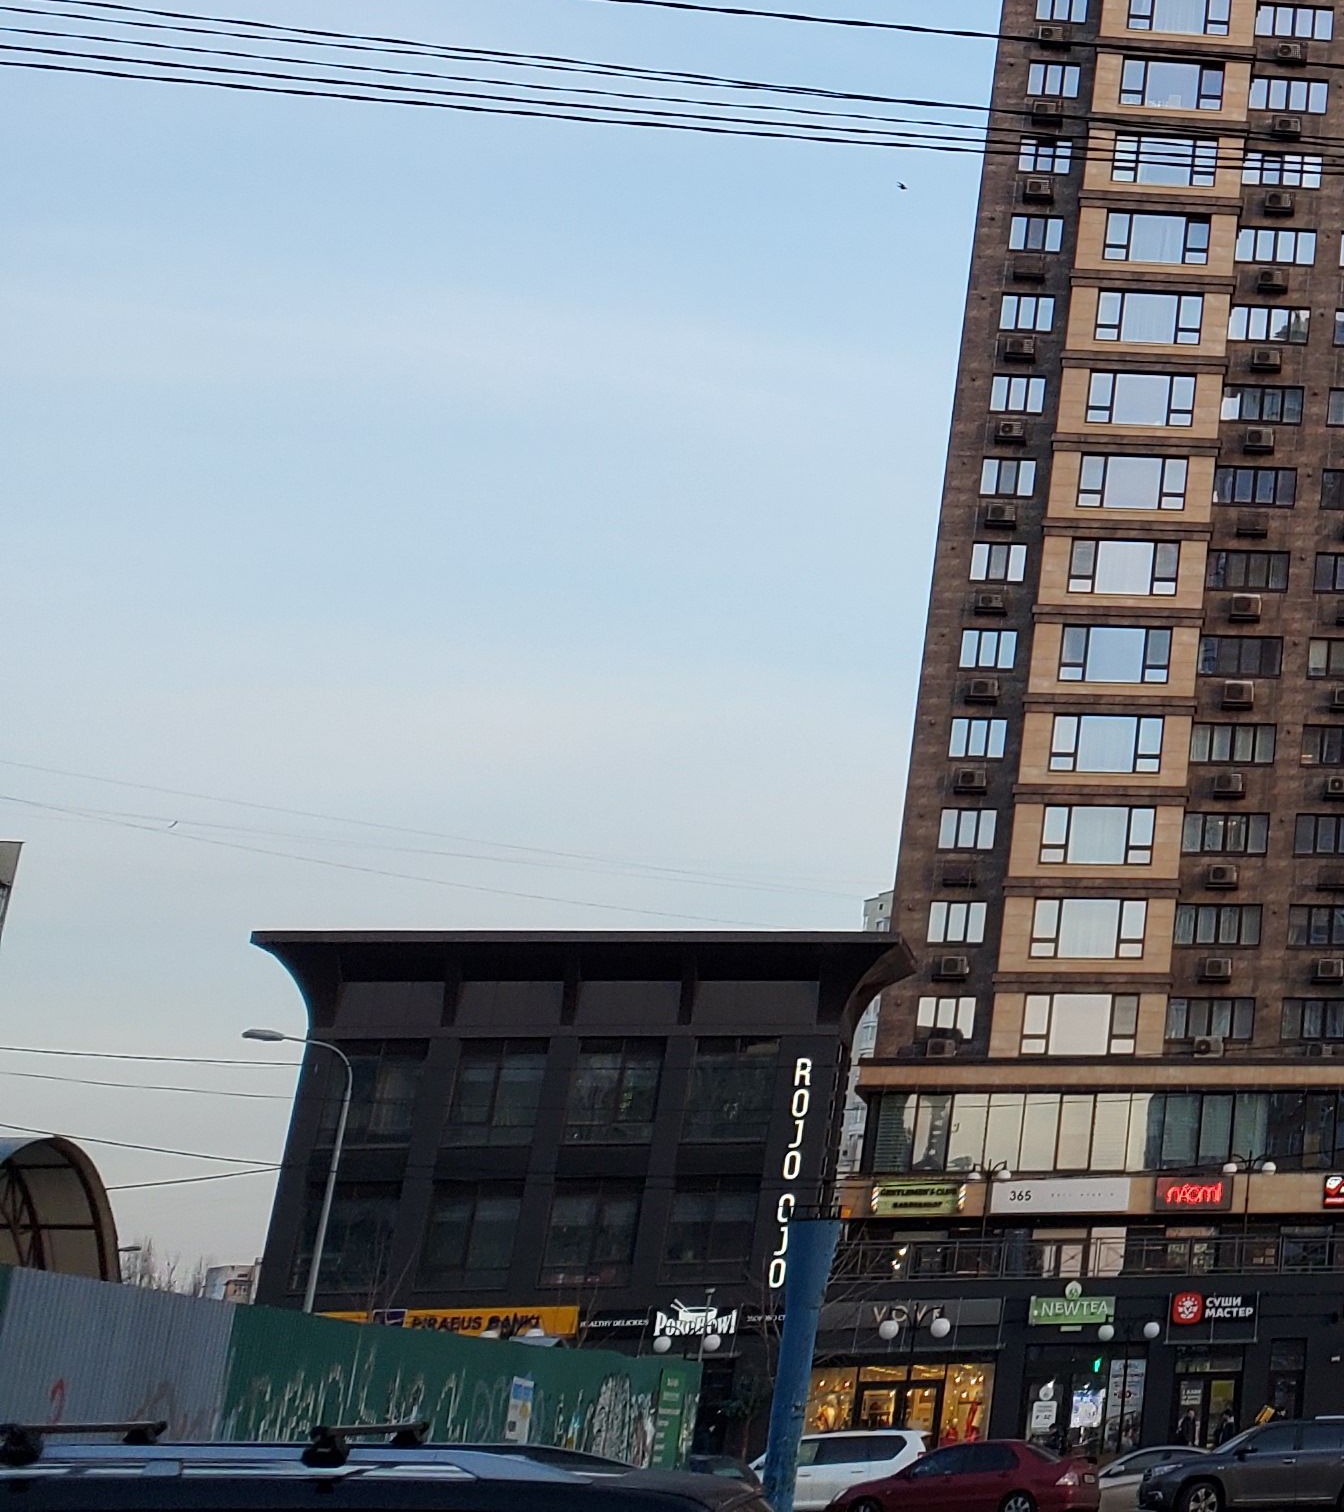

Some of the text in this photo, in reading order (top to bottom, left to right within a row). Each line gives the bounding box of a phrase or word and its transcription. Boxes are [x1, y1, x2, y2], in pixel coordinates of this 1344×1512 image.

[783, 1057, 813, 1180] ROJO
[1009, 1190, 1032, 1202] 365
[1206, 1296, 1242, 1307] СУШИ
[1204, 1307, 1254, 1318] МАСТЕР
[412, 1315, 483, 1332] PIRAEUS
